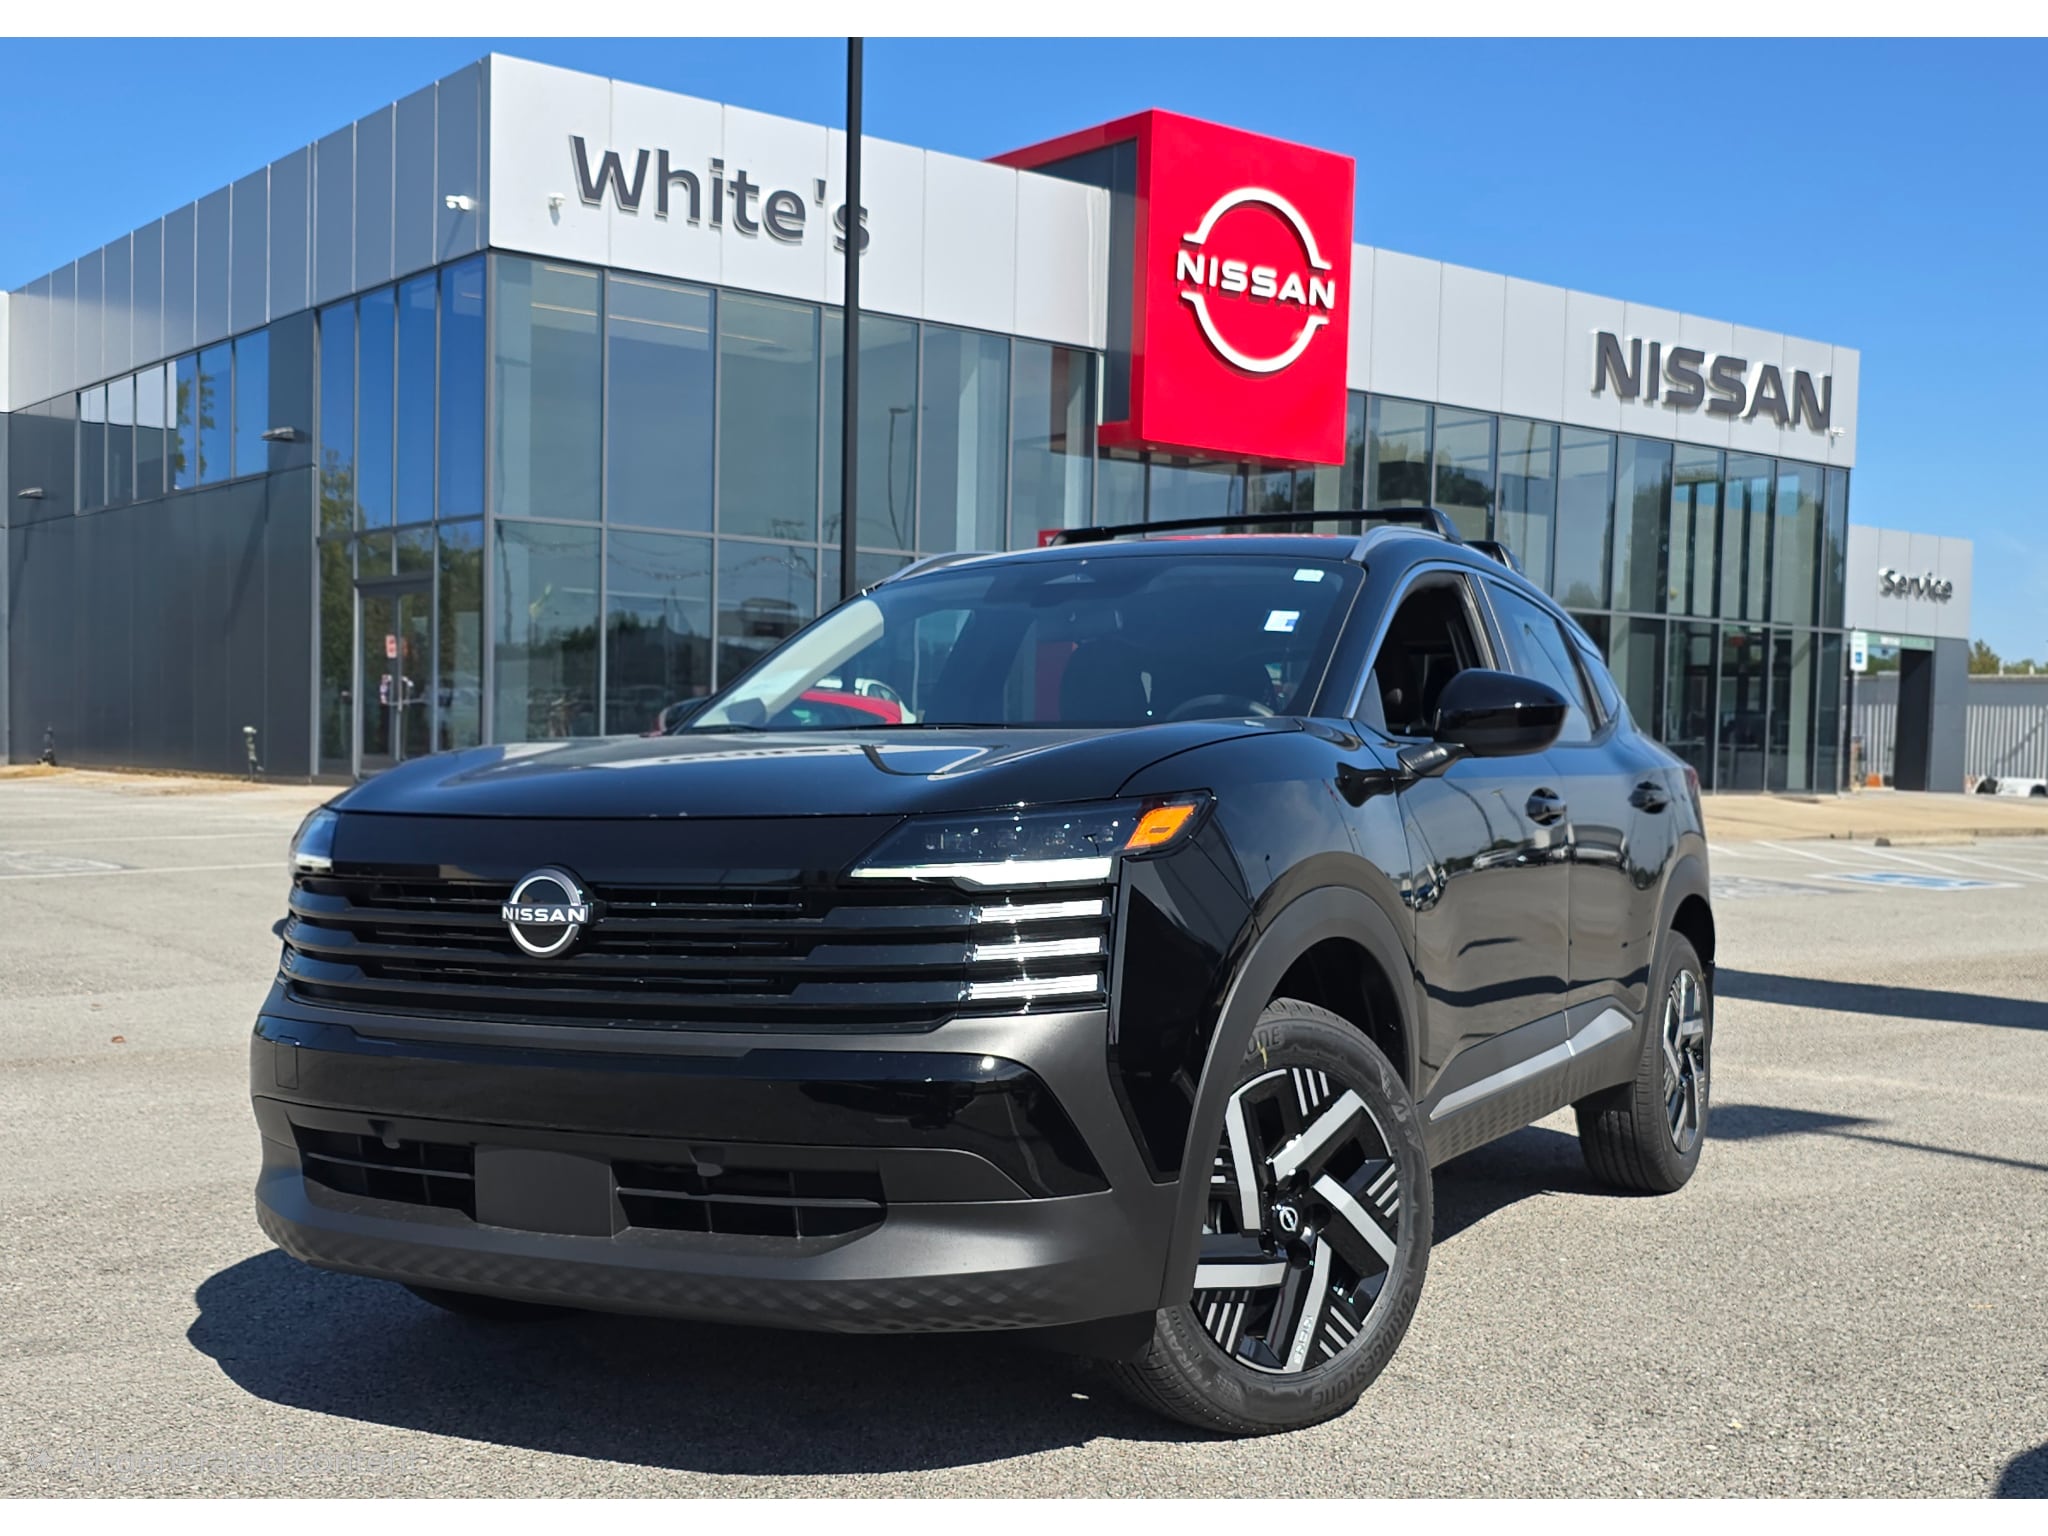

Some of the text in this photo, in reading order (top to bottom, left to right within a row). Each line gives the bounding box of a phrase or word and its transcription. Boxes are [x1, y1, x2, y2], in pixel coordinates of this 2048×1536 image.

[568, 135, 870, 253] White's
[1176, 249, 1336, 310] NISSAN
[1592, 330, 1832, 431] NISSAN
[1880, 569, 1953, 603] Service
[501, 906, 585, 922] NISSAN
